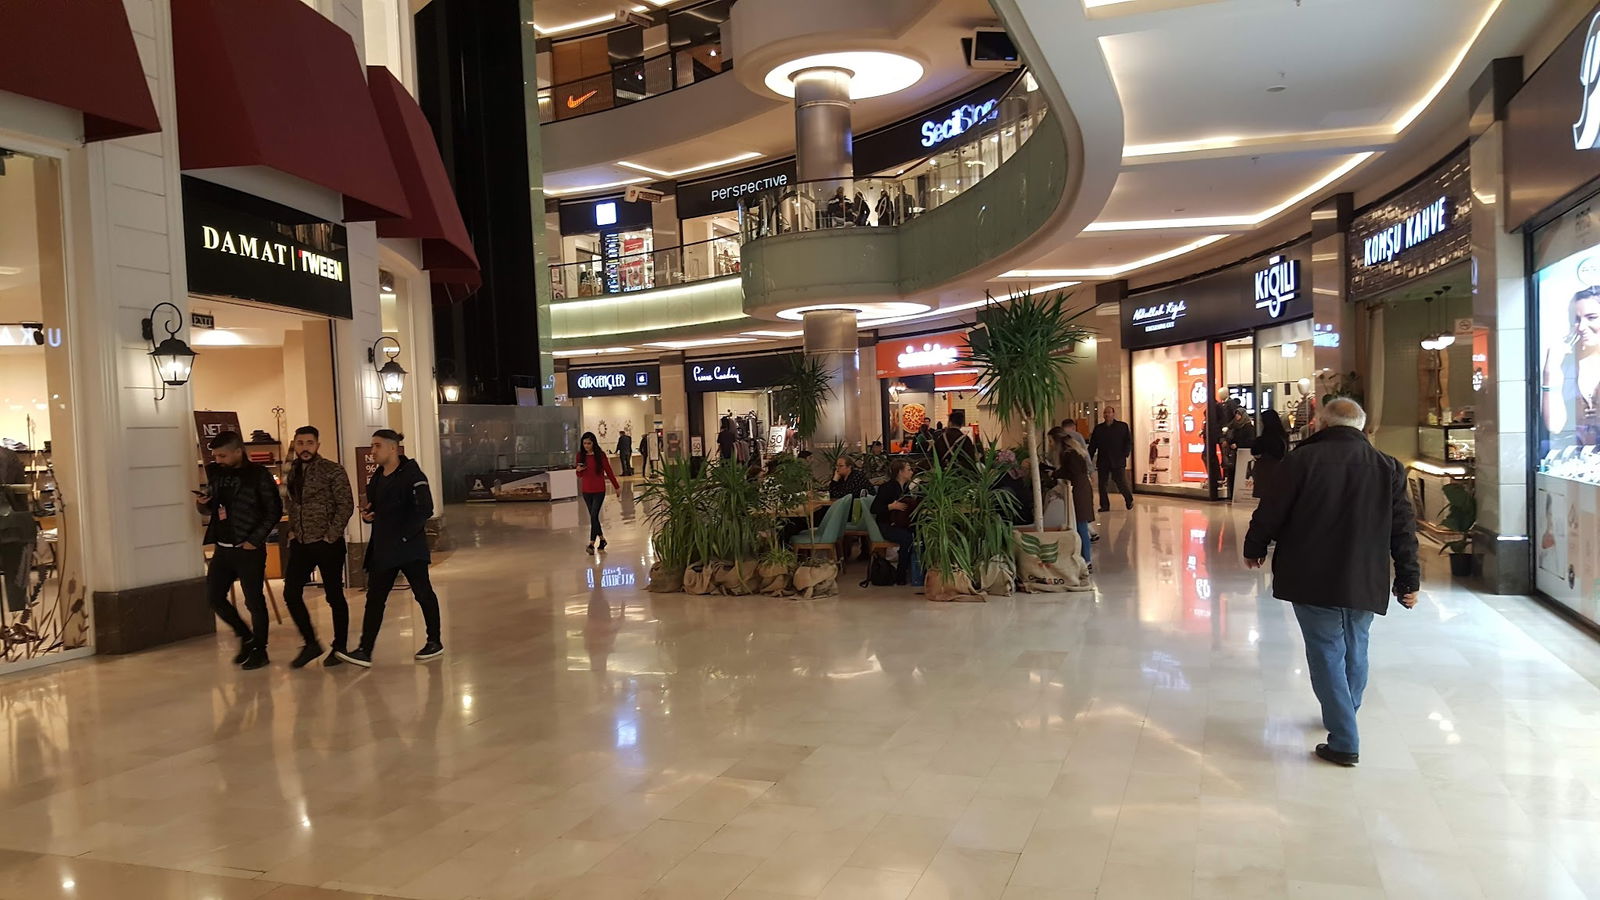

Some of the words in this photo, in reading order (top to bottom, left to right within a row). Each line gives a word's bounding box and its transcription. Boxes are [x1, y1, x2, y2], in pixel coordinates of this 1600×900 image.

[1364, 223, 1402, 267] KOMŞU
[1405, 196, 1446, 249] KAHVE
[202, 225, 287, 265] DAMAT
[577, 374, 626, 391] GÜRGENÇLER
[693, 365, 713, 382] Pierre
[713, 365, 742, 384] Cardin
[203, 423, 221, 436] NET
